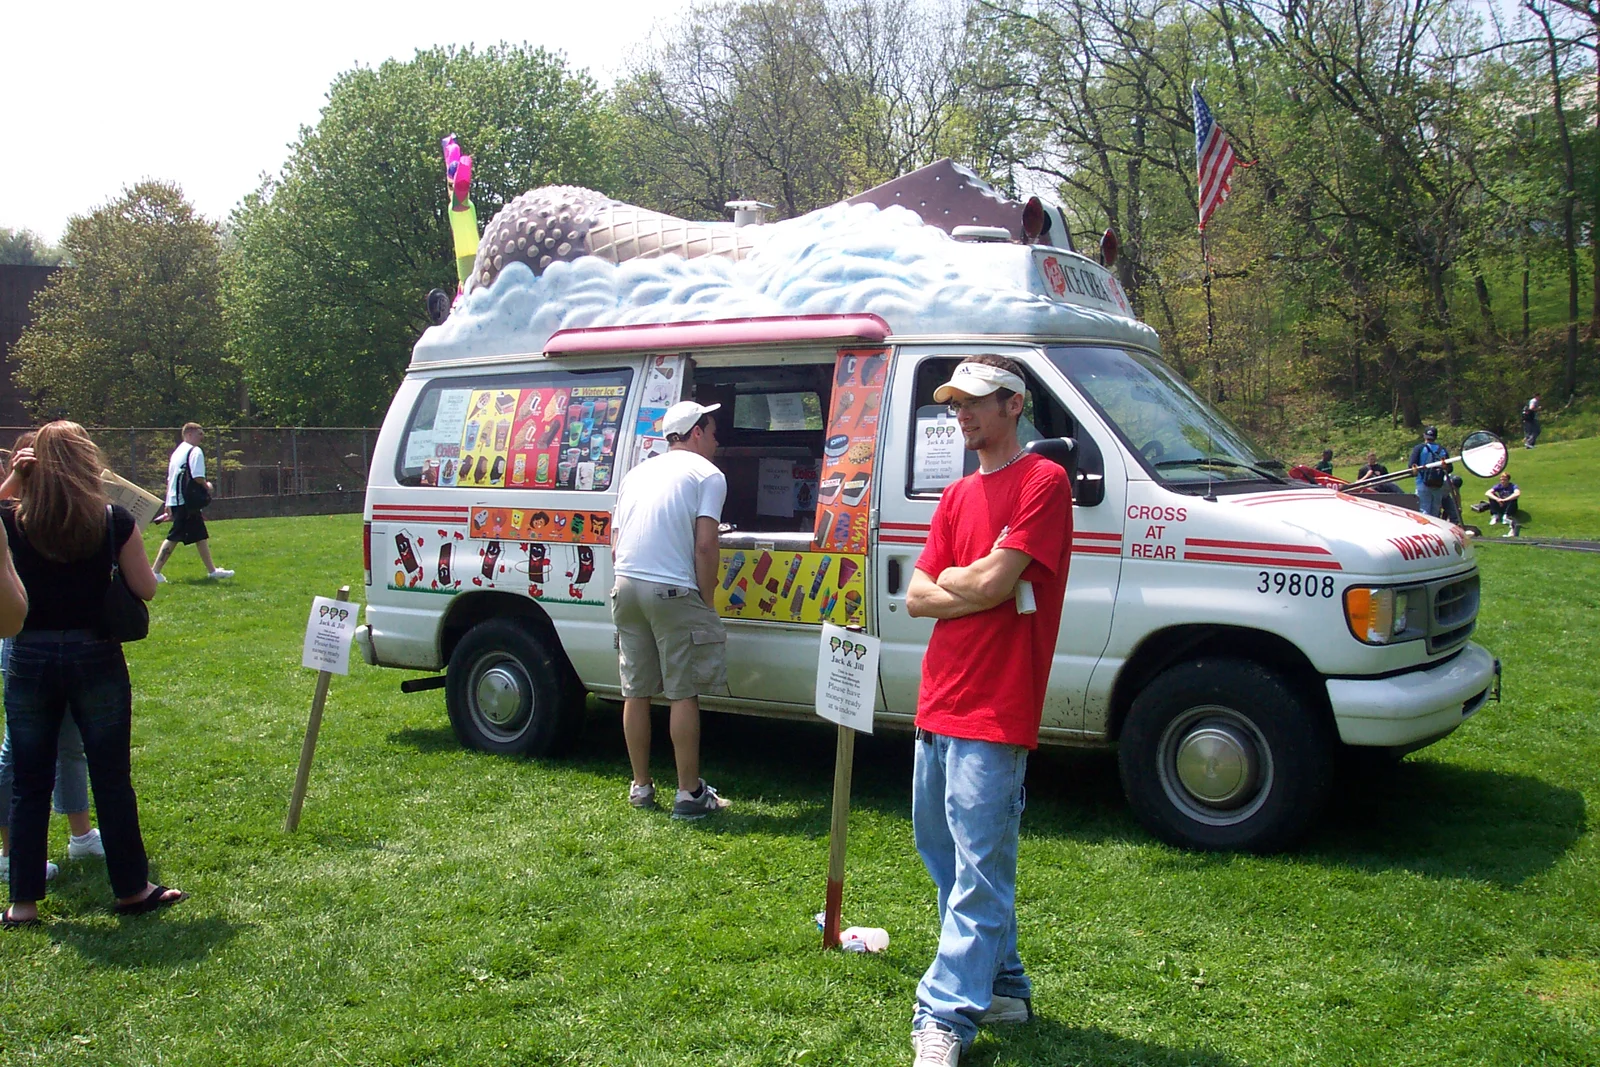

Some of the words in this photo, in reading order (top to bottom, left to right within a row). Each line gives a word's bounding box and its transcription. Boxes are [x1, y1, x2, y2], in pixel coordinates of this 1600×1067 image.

[1058, 264, 1085, 296] ICE
[582, 388, 603, 396] Water
[604, 387, 615, 396] Ice
[435, 443, 460, 458] Coke
[1127, 505, 1187, 522] CROSS
[1145, 525, 1166, 540] AT
[1131, 543, 1176, 560] REAR
[1386, 533, 1450, 561] WATCH
[1257, 571, 1334, 598] 39808
[831, 655, 845, 666] Jack
[846, 660, 852, 668] &
[853, 661, 865, 672] Jill
[828, 682, 846, 694] Please
[846, 687, 861, 698] have
[825, 692, 844, 704] money
[845, 698, 862, 710] ready
[834, 704, 857, 717] window
